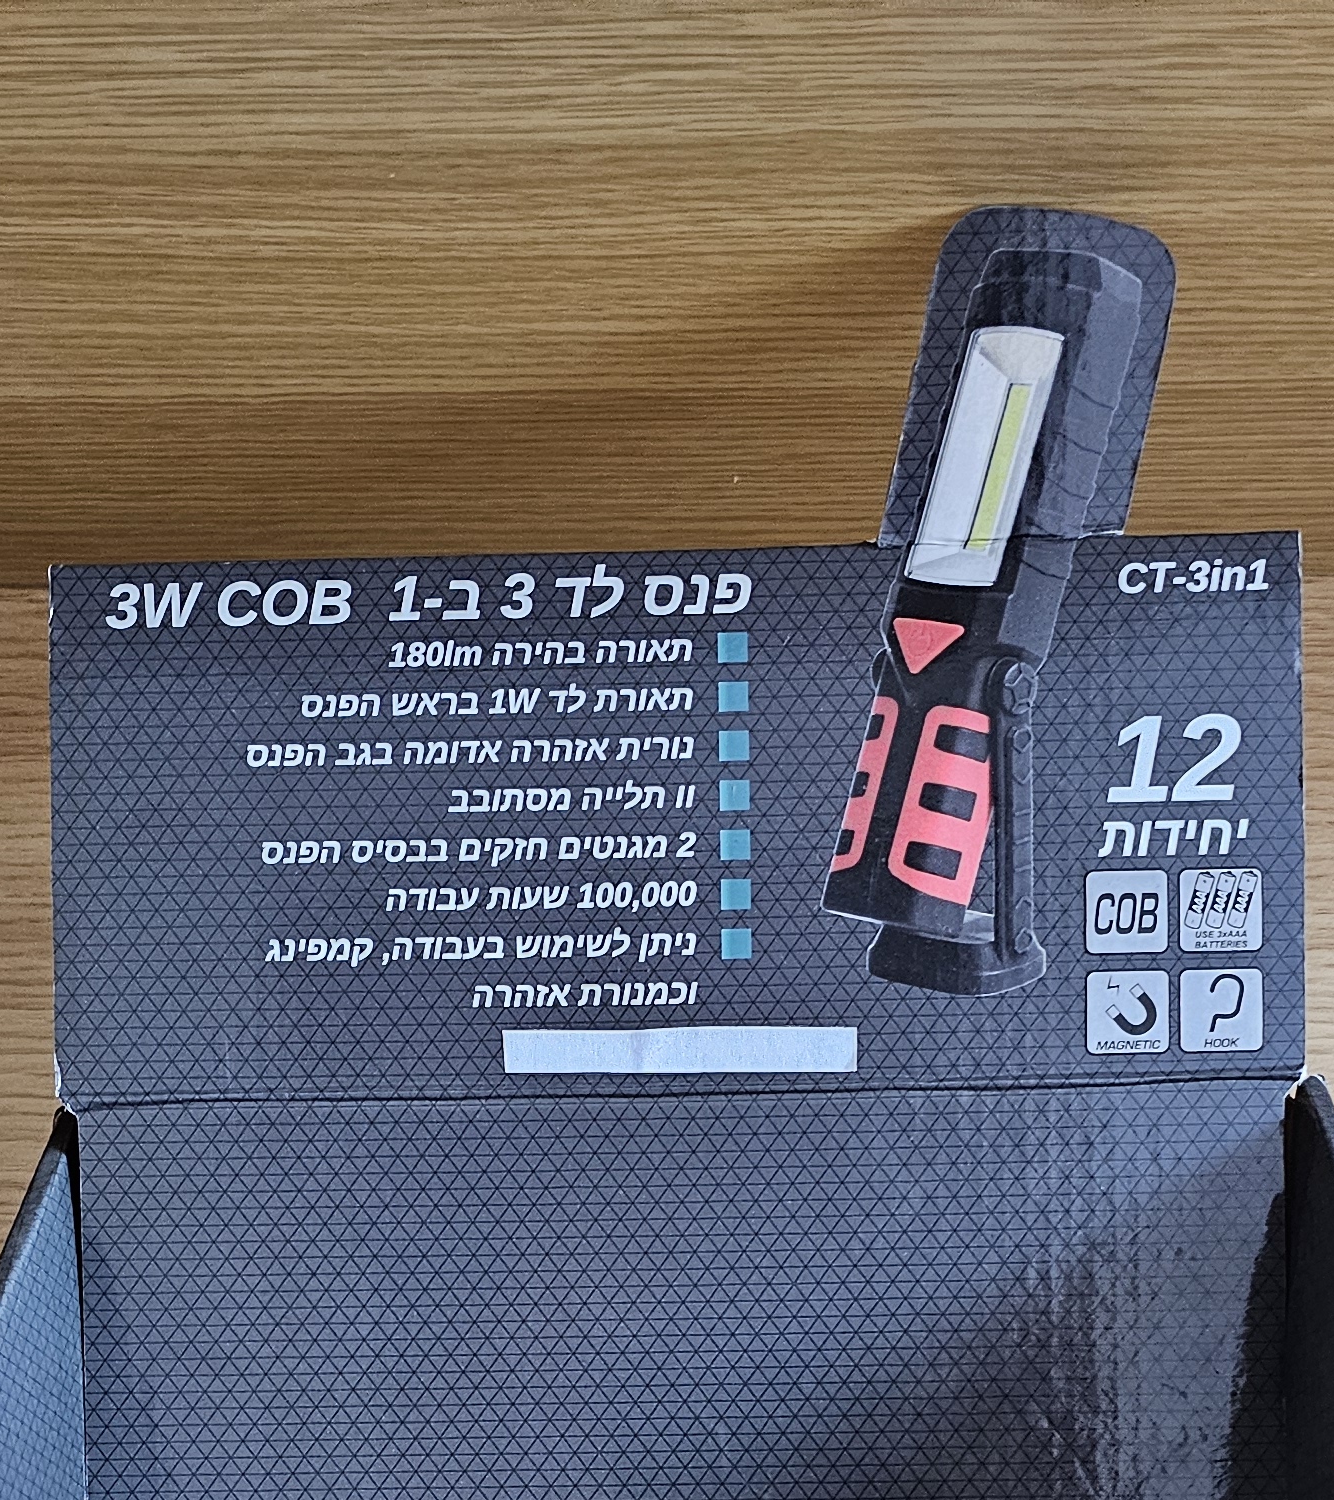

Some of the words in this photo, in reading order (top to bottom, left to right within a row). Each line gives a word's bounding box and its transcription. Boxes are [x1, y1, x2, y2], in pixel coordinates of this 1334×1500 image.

[1118, 558, 1269, 594] CT-3in1
[217, 579, 352, 627] COB
[499, 572, 536, 619] 3
[555, 563, 625, 619] לד
[644, 573, 752, 616] פנס
[105, 581, 204, 630] 3W
[388, 639, 483, 668] 180lm
[491, 641, 586, 666] בהירה
[595, 638, 693, 664] תאורה
[301, 693, 381, 718] הפנס
[391, 692, 479, 716] בראש
[488, 687, 542, 715] 1W
[548, 685, 587, 714] לד
[593, 687, 694, 713] תאורת
[246, 743, 326, 768] הפנס
[334, 742, 393, 766] בגב
[403, 740, 503, 765] אדומה
[510, 738, 610, 764] אזהרה
[616, 736, 695, 763] נורית
[1106, 713, 1242, 803] 12
[447, 785, 572, 813] מסתובב
[581, 780, 666, 811] תלייה
[675, 784, 696, 809] וו
[351, 838, 449, 864] בבסיס
[557, 834, 668, 860] מגנטים
[675, 831, 697, 858] 2
[1097, 818, 1250, 858] יחידות
[261, 840, 341, 865] הפנס
[458, 837, 548, 868] חזקים
[385, 886, 478, 912] עבודה
[485, 884, 570, 911] שעות
[576, 880, 698, 913] 100,000
[1094, 893, 1159, 935] COB
[516, 927, 631, 961] לשימוש
[638, 932, 697, 963] ניתן
[1195, 930, 1215, 939] USE
[1195, 940, 1248, 949] BATTERIES
[264, 937, 374, 968] קמפינג
[381, 936, 505, 966] בעבודה,
[471, 983, 571, 1008] אזהרה
[578, 981, 699, 1007] וכמנורת
[1096, 1039, 1161, 1050] MAGNETIC
[1204, 1037, 1240, 1048] HOOK
